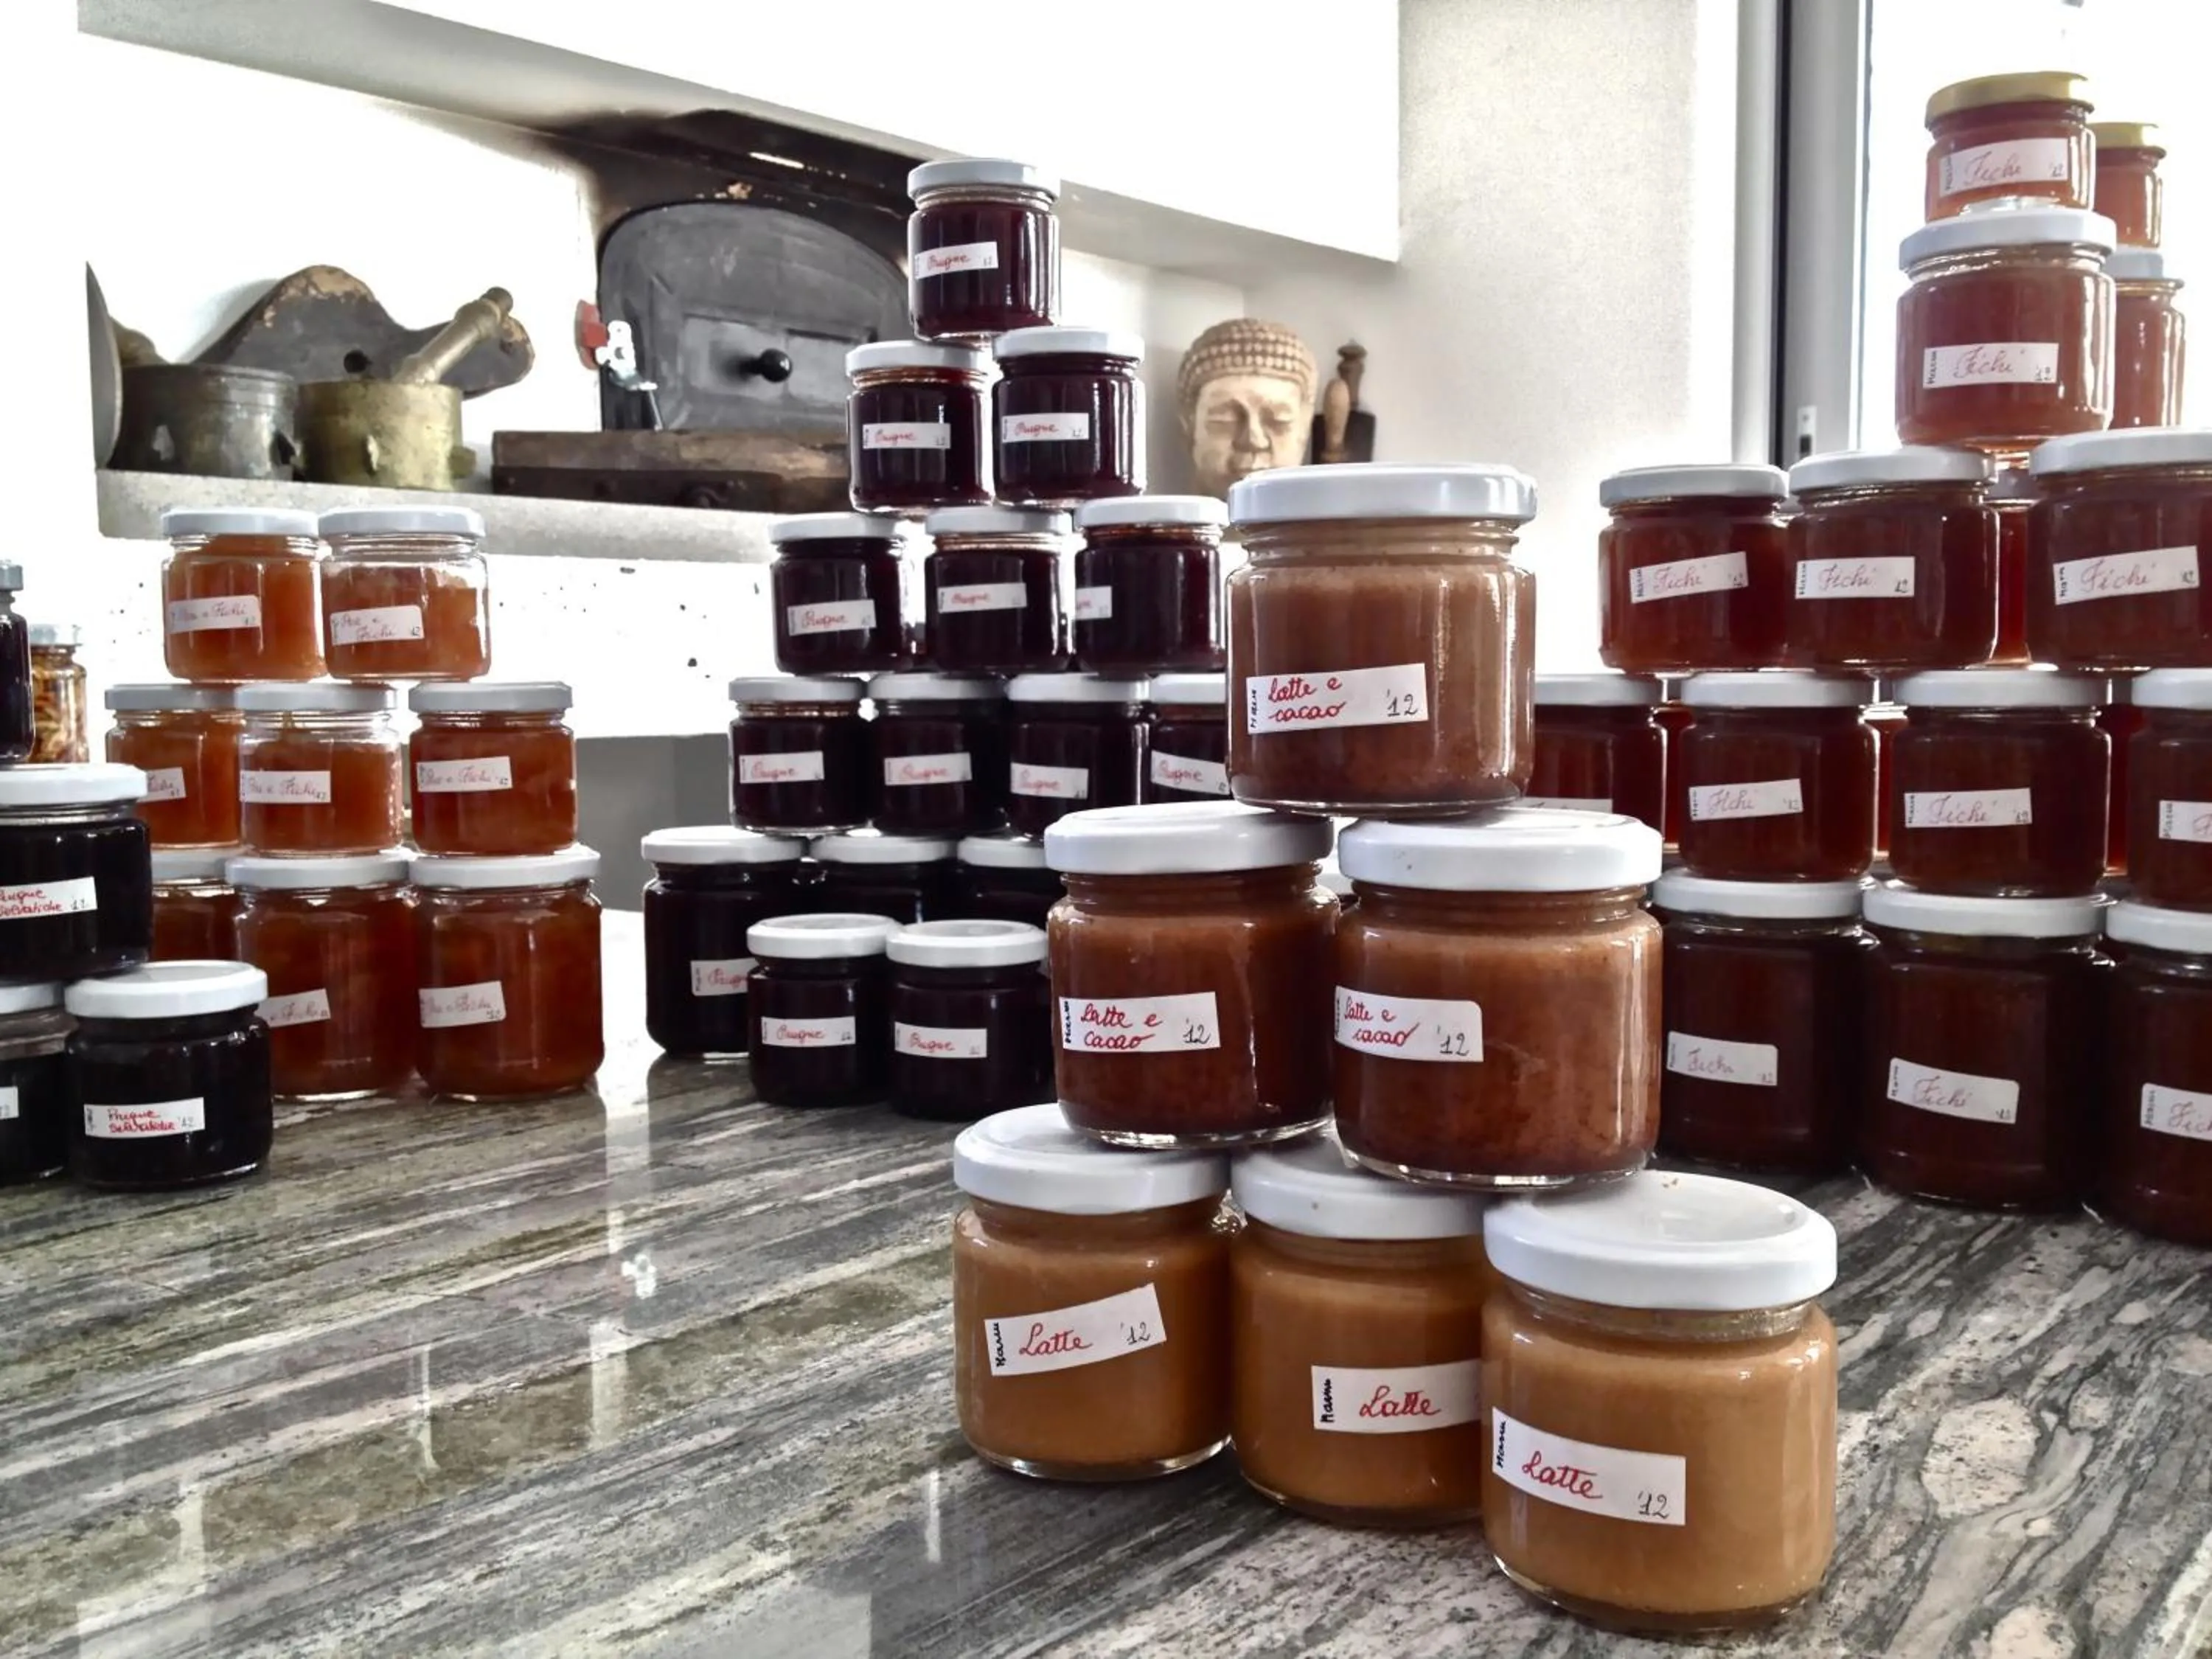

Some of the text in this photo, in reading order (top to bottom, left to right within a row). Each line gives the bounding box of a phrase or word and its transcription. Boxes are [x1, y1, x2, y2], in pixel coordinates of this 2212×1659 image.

[1327, 677, 1343, 690] e
[1268, 701, 1346, 722] cacao
[1144, 1013, 1163, 1026] e
[1381, 1008, 1397, 1023] e
[1018, 1323, 1093, 1357] Latte
[1359, 1385, 1442, 1418] Latte
[1522, 1451, 1603, 1500] Latte
